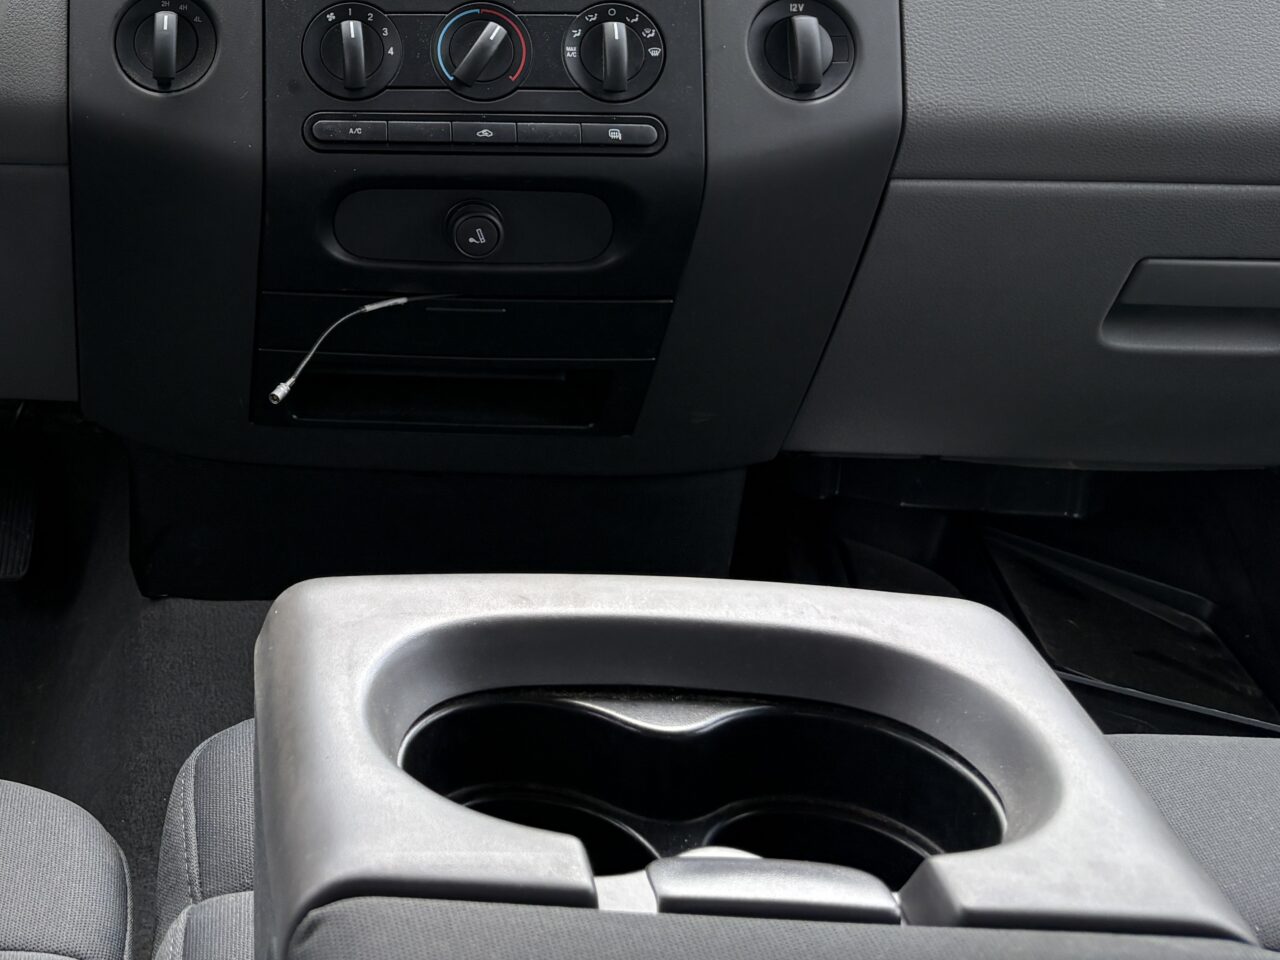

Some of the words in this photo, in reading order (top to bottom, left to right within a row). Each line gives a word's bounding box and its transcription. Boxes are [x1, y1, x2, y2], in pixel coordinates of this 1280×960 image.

[160, 0, 170, 8] 2H
[178, 3, 188, 12] 4H
[789, 3, 805, 12] 12V
[193, 15, 203, 23] 4L
[367, 12, 374, 21] 2
[381, 27, 389, 37] 3
[387, 46, 394, 56] 4
[348, 127, 362, 135] A/C
